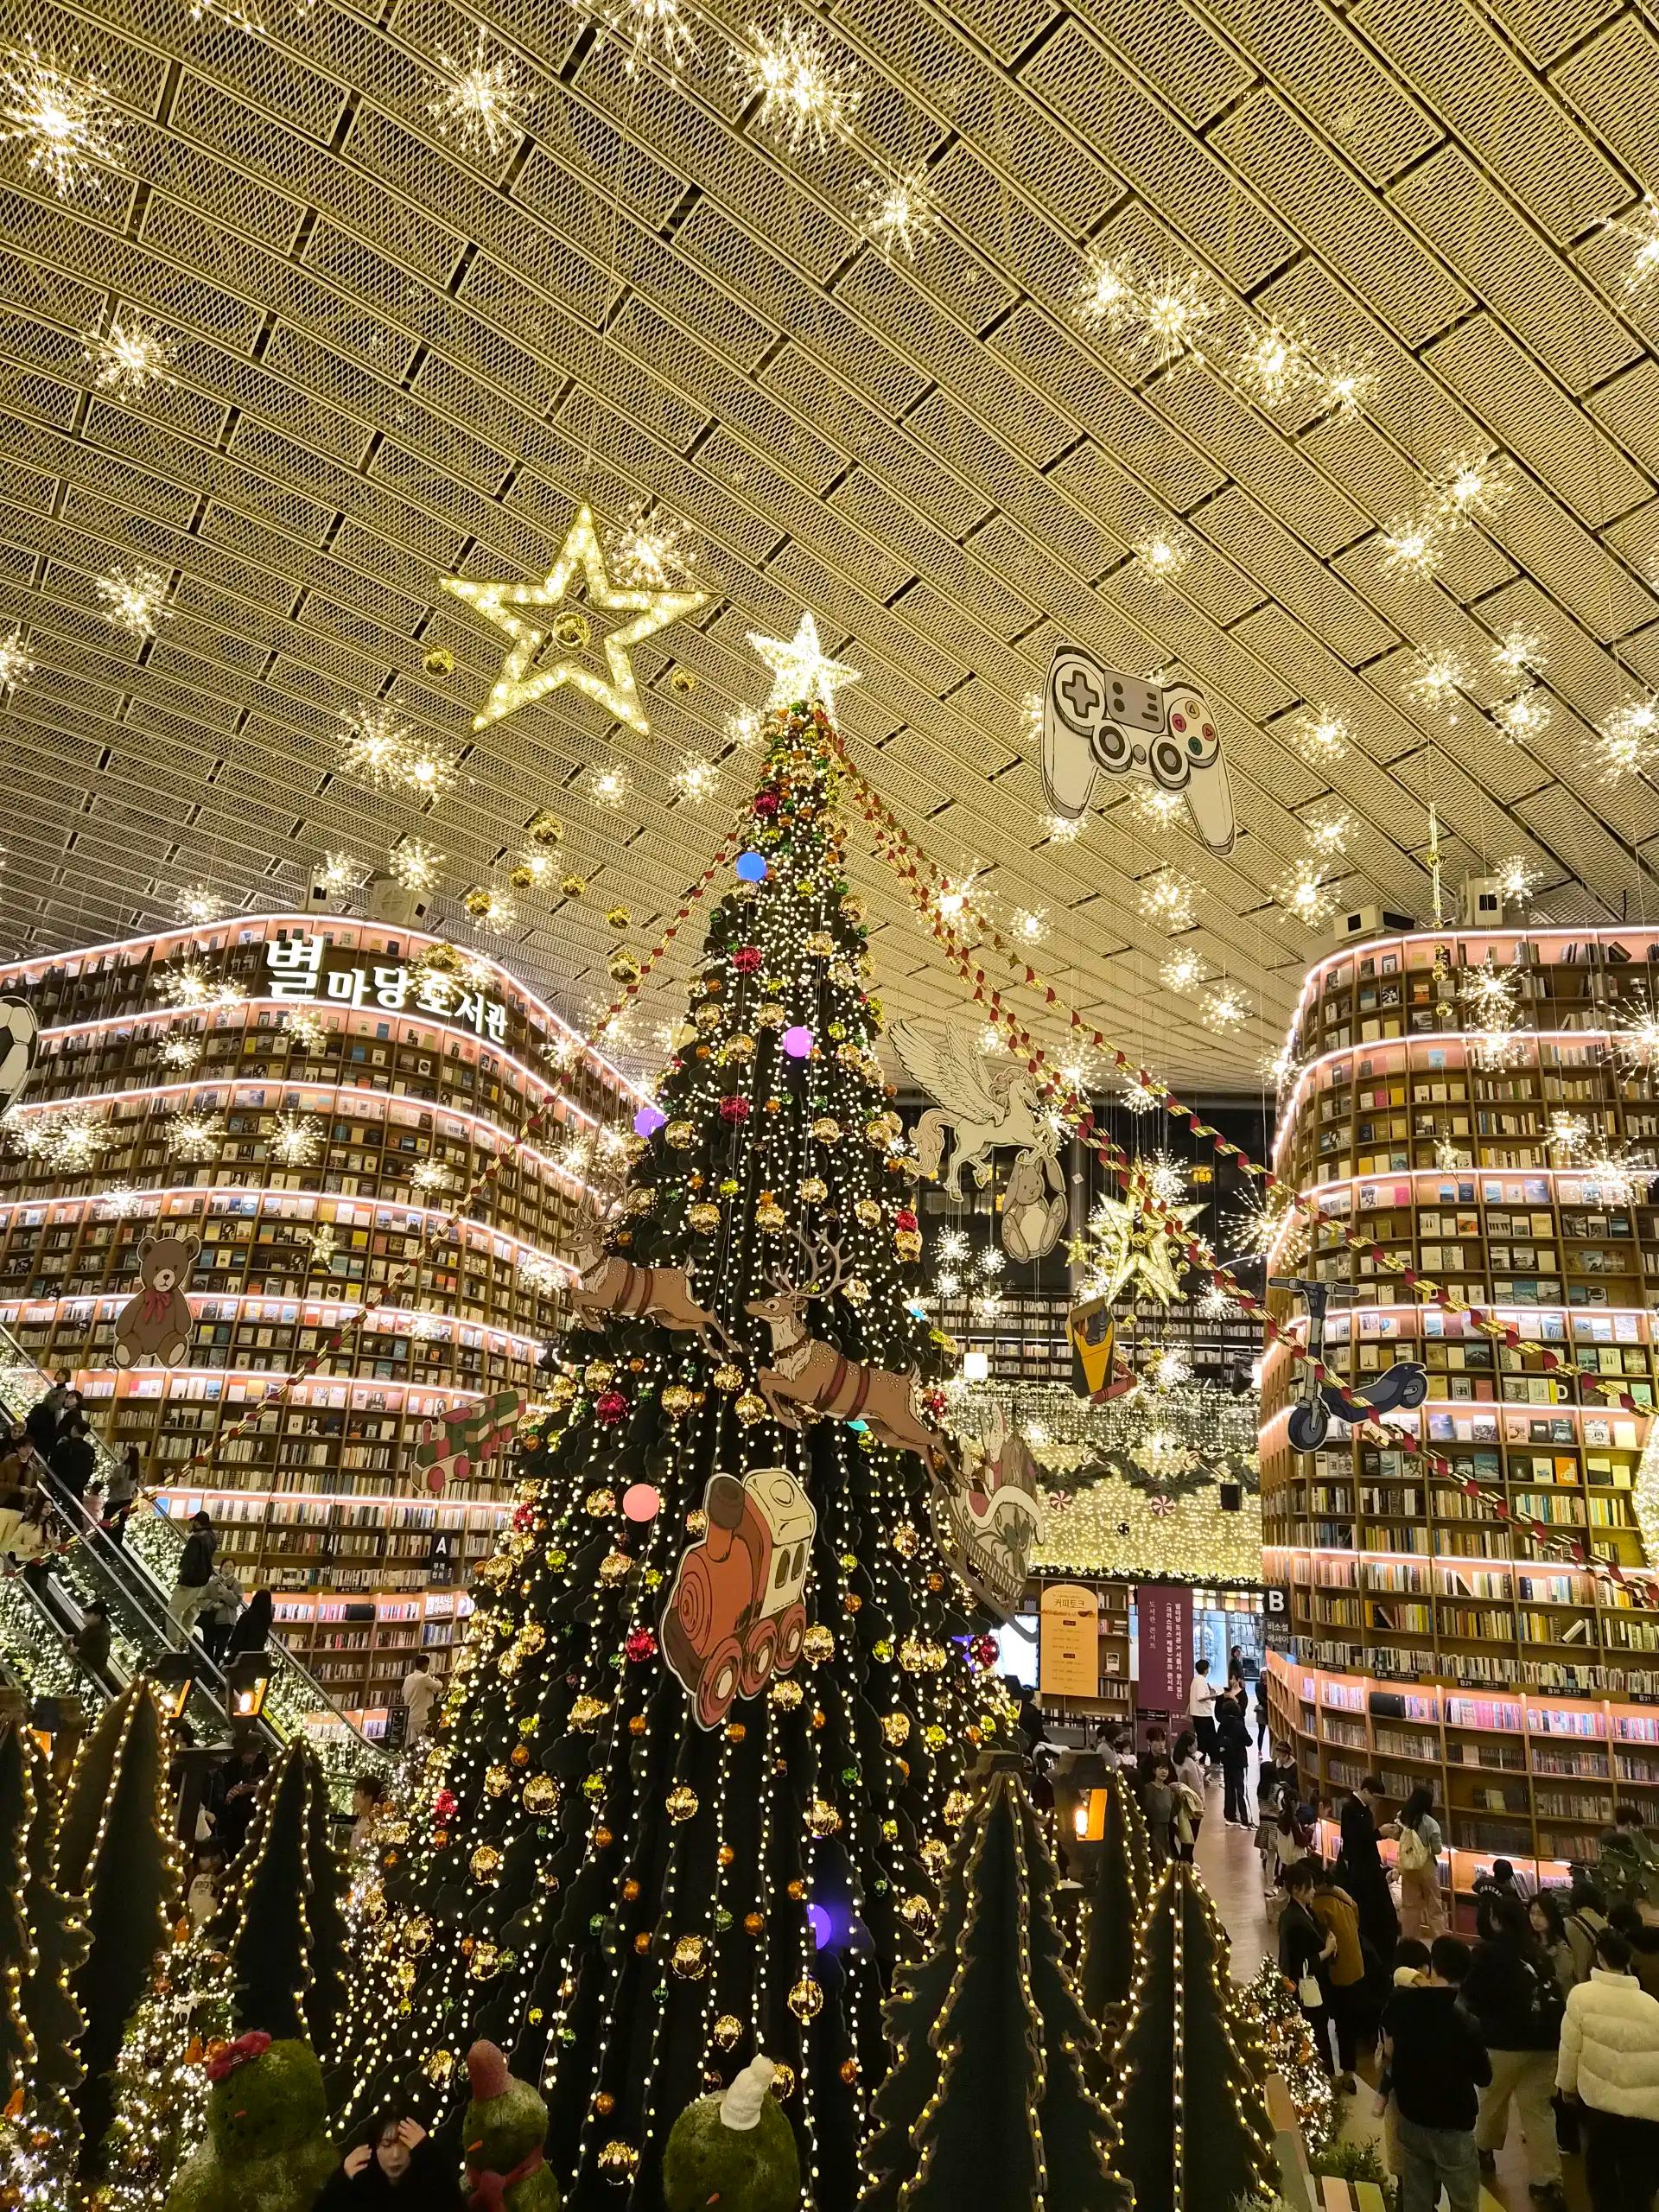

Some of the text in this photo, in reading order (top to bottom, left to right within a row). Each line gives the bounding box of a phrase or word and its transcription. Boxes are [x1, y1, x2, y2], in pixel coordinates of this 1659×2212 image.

[265, 934, 508, 1045] 별마당 도서관
[435, 1536, 447, 1554] A
[1268, 1590, 1285, 1612] B
[1267, 1621, 1288, 1632] 비소설
[1267, 1634, 1289, 1644] 에세이
[1459, 1679, 1472, 1688] B29
